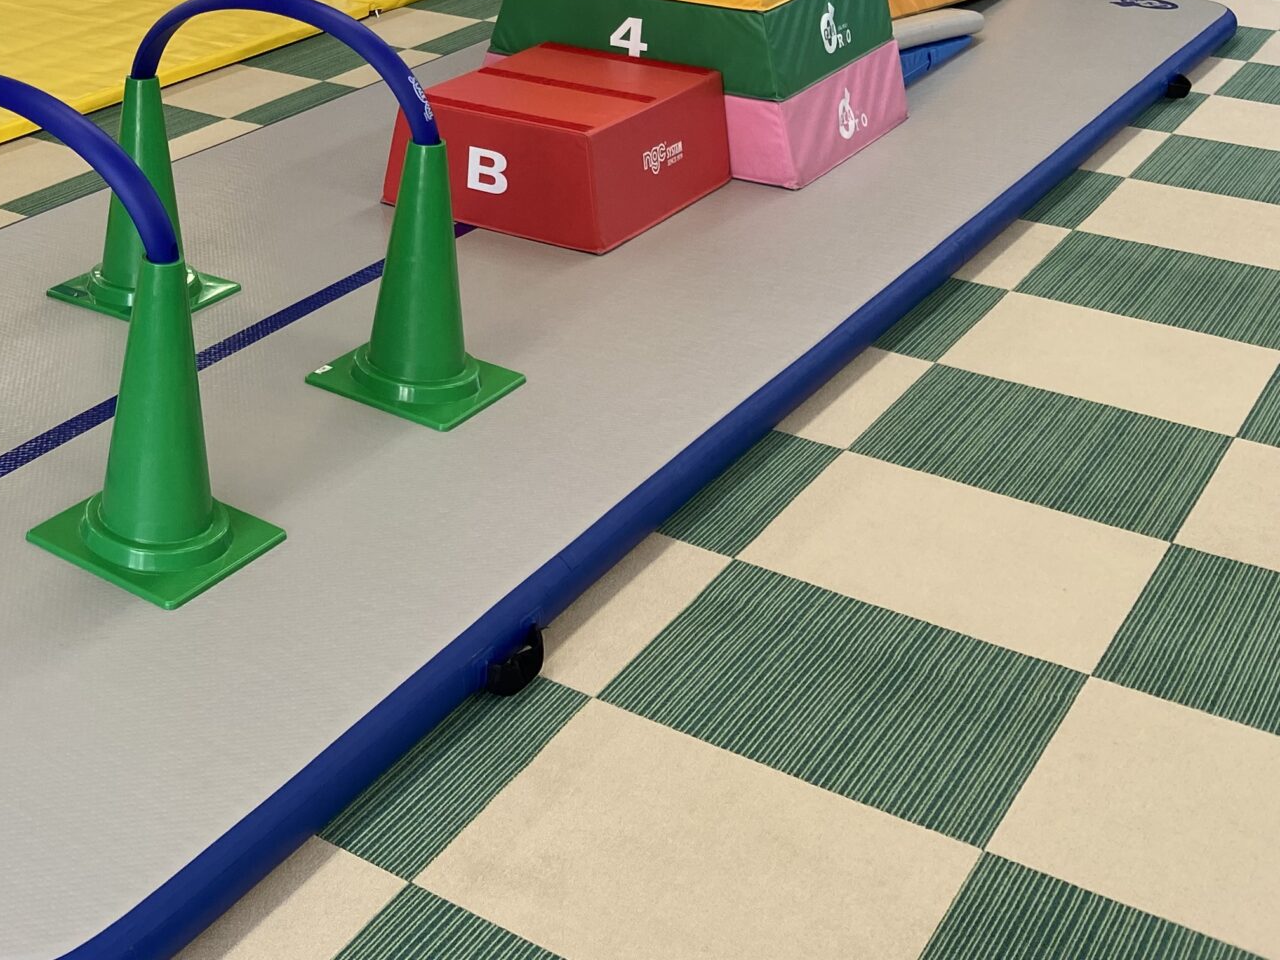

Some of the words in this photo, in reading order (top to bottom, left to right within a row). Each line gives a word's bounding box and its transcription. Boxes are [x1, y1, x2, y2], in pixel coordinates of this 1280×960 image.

[609, 16, 648, 58] 4
[466, 145, 509, 196] B
[643, 142, 666, 175] ngc
[666, 141, 683, 159] SYSTEM
